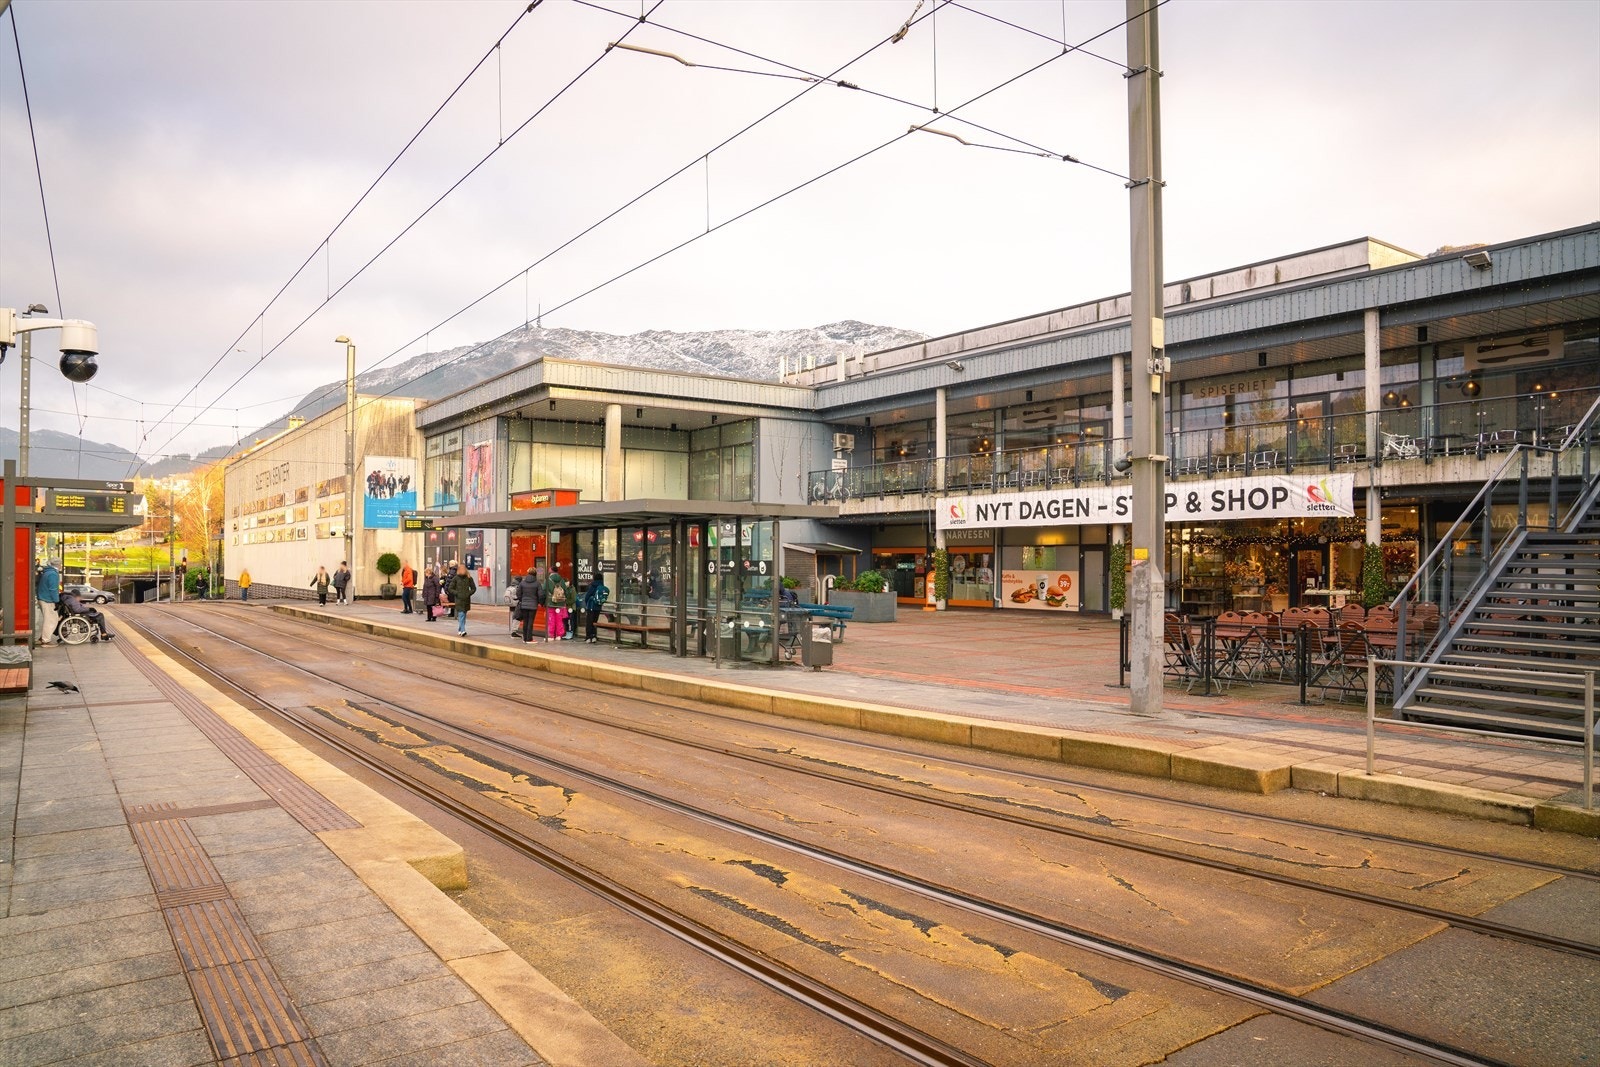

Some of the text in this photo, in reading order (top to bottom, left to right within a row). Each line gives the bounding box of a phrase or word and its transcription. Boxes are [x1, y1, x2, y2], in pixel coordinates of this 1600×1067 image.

[1200, 380, 1268, 398] SPISERIET
[119, 482, 125, 490] 1
[976, 502, 1013, 521] NYT
[1019, 497, 1090, 520] DAGEN
[1116, 493, 1177, 516] SP
[1186, 491, 1202, 513] &
[1211, 486, 1288, 512] SHOP
[1306, 503, 1336, 511] sletten
[945, 530, 990, 540] NARVESEN
